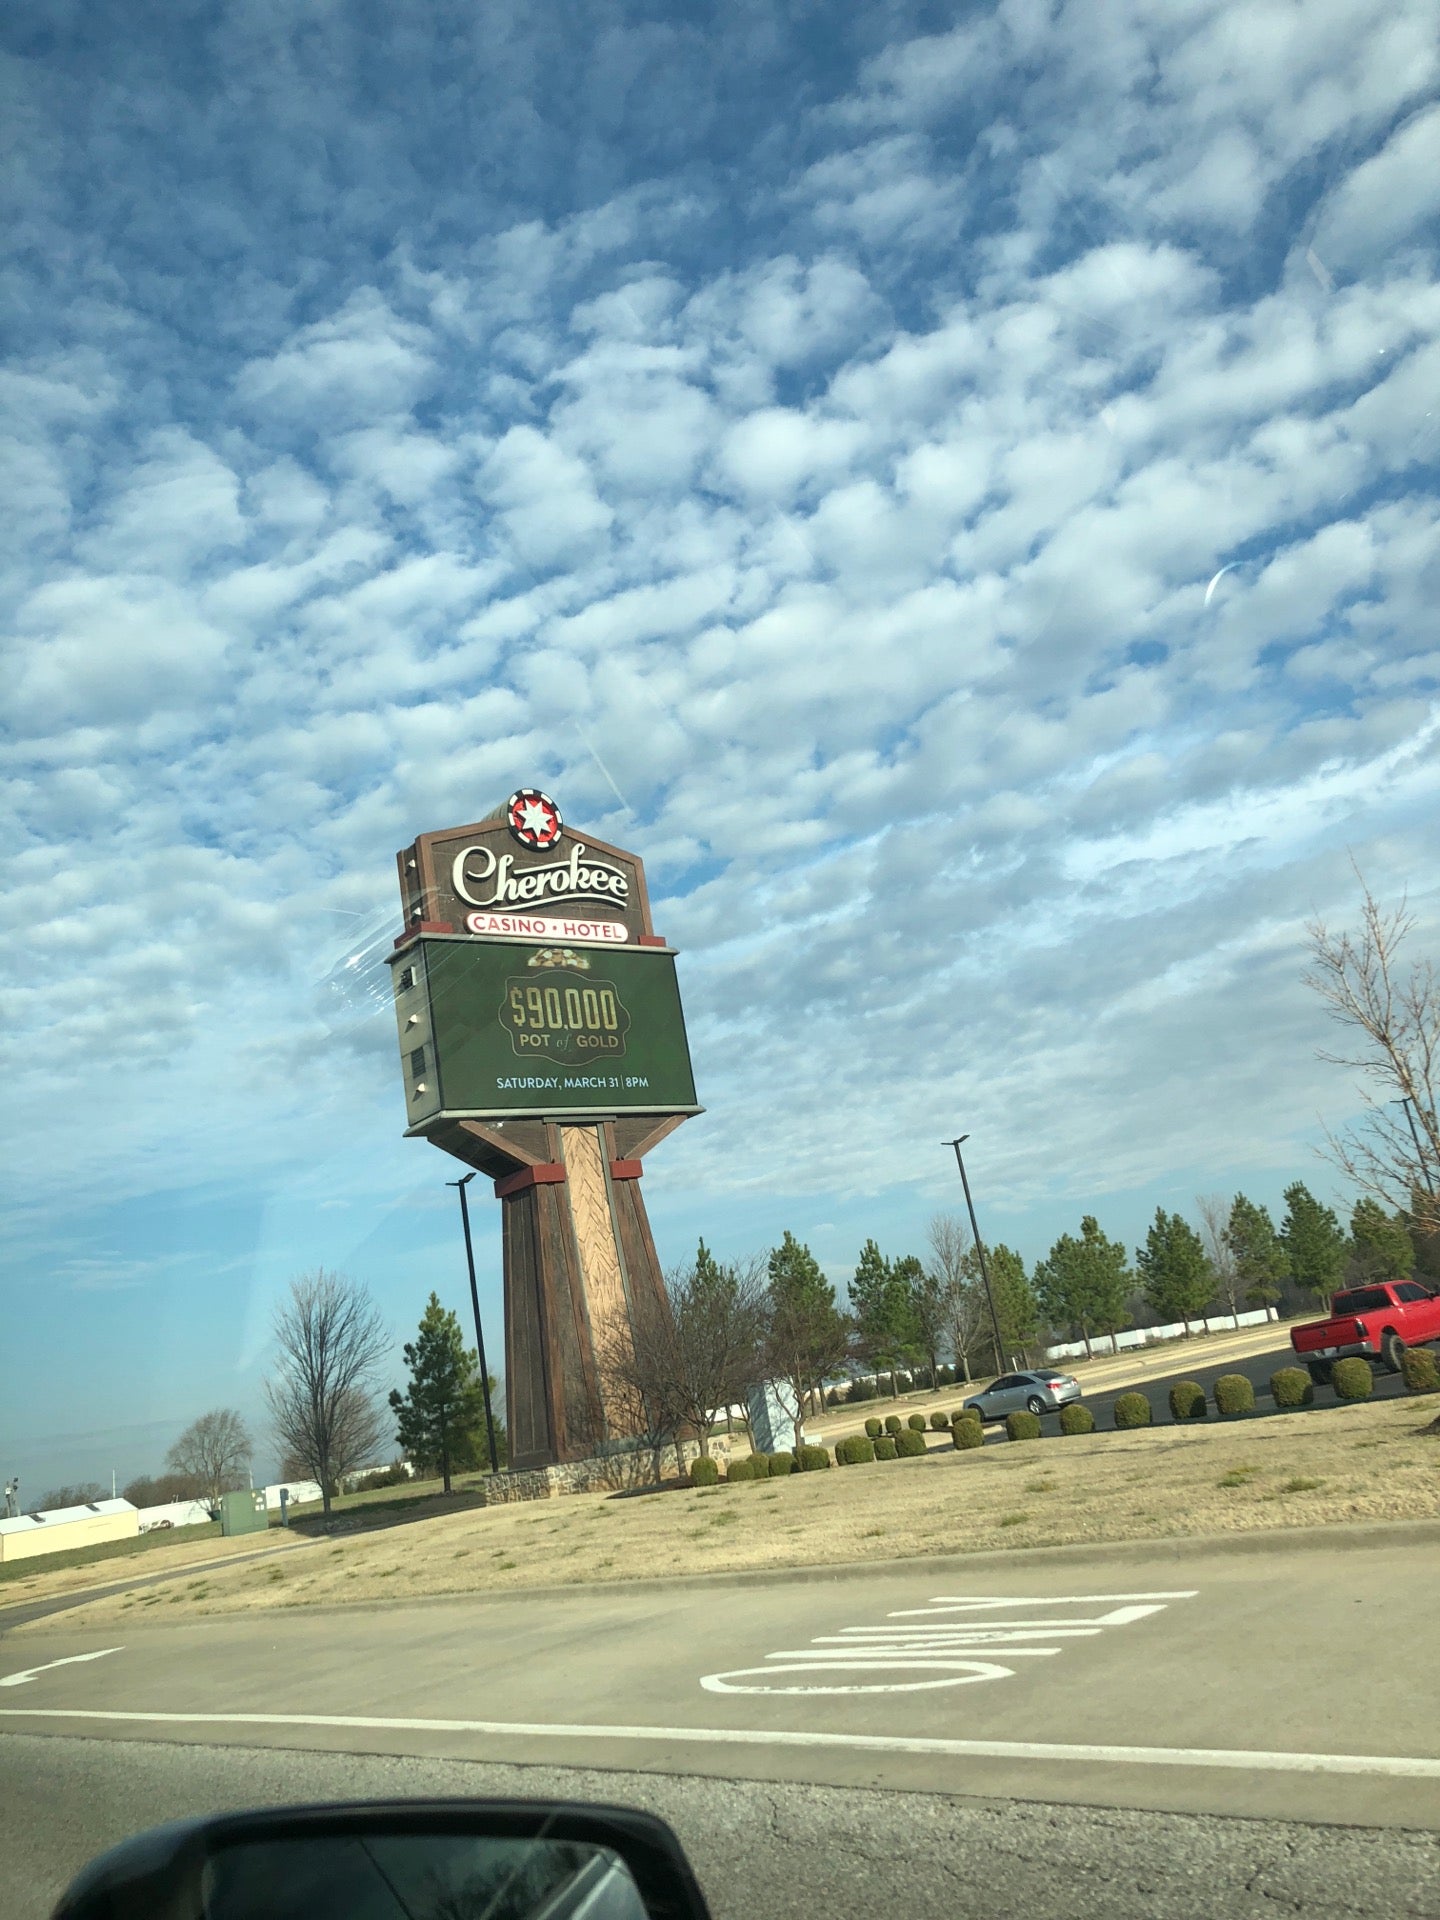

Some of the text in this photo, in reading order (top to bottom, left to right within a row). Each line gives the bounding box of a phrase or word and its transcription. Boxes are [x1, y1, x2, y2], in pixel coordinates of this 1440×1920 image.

[452, 843, 629, 905] Cherokee
[473, 916, 622, 939] CASINO HOTEL
[510, 987, 618, 1030] $90,000
[519, 1034, 550, 1047] POT
[576, 1035, 619, 1048] GOLD
[496, 1076, 649, 1090] SATURDAY, MARCH 31 8PM
[699, 1590, 1199, 1695] ONLY
